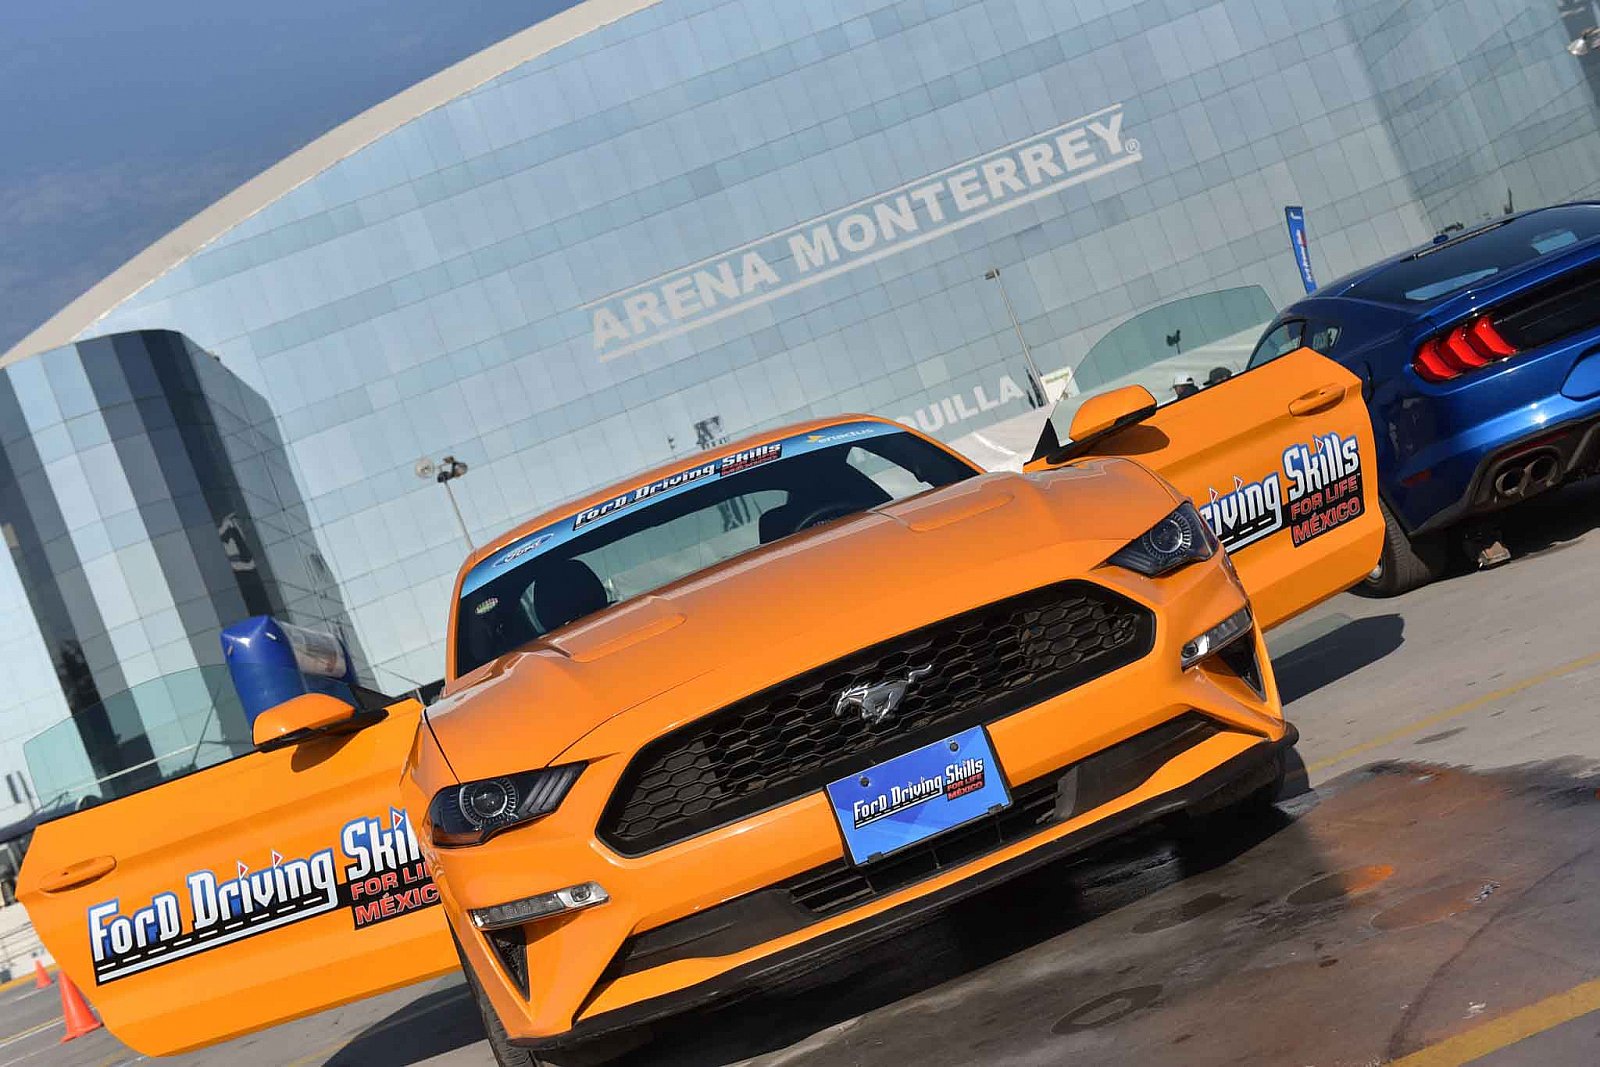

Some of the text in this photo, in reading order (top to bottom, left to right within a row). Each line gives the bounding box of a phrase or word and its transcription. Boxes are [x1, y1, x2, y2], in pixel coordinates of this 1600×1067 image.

[592, 251, 781, 350] ARENA
[635, 463, 715, 501] Driving
[721, 443, 781, 468] Skills
[1283, 433, 1360, 501] Skills
[1290, 475, 1359, 520] FOR LIFE
[1292, 496, 1361, 544] MÉXICO
[890, 775, 944, 806] Driving
[945, 758, 984, 784] Skills
[188, 849, 338, 929] Driving
[342, 809, 421, 881] Skil
[350, 861, 433, 900] FOR LI
[354, 883, 440, 925] MÉXIC
